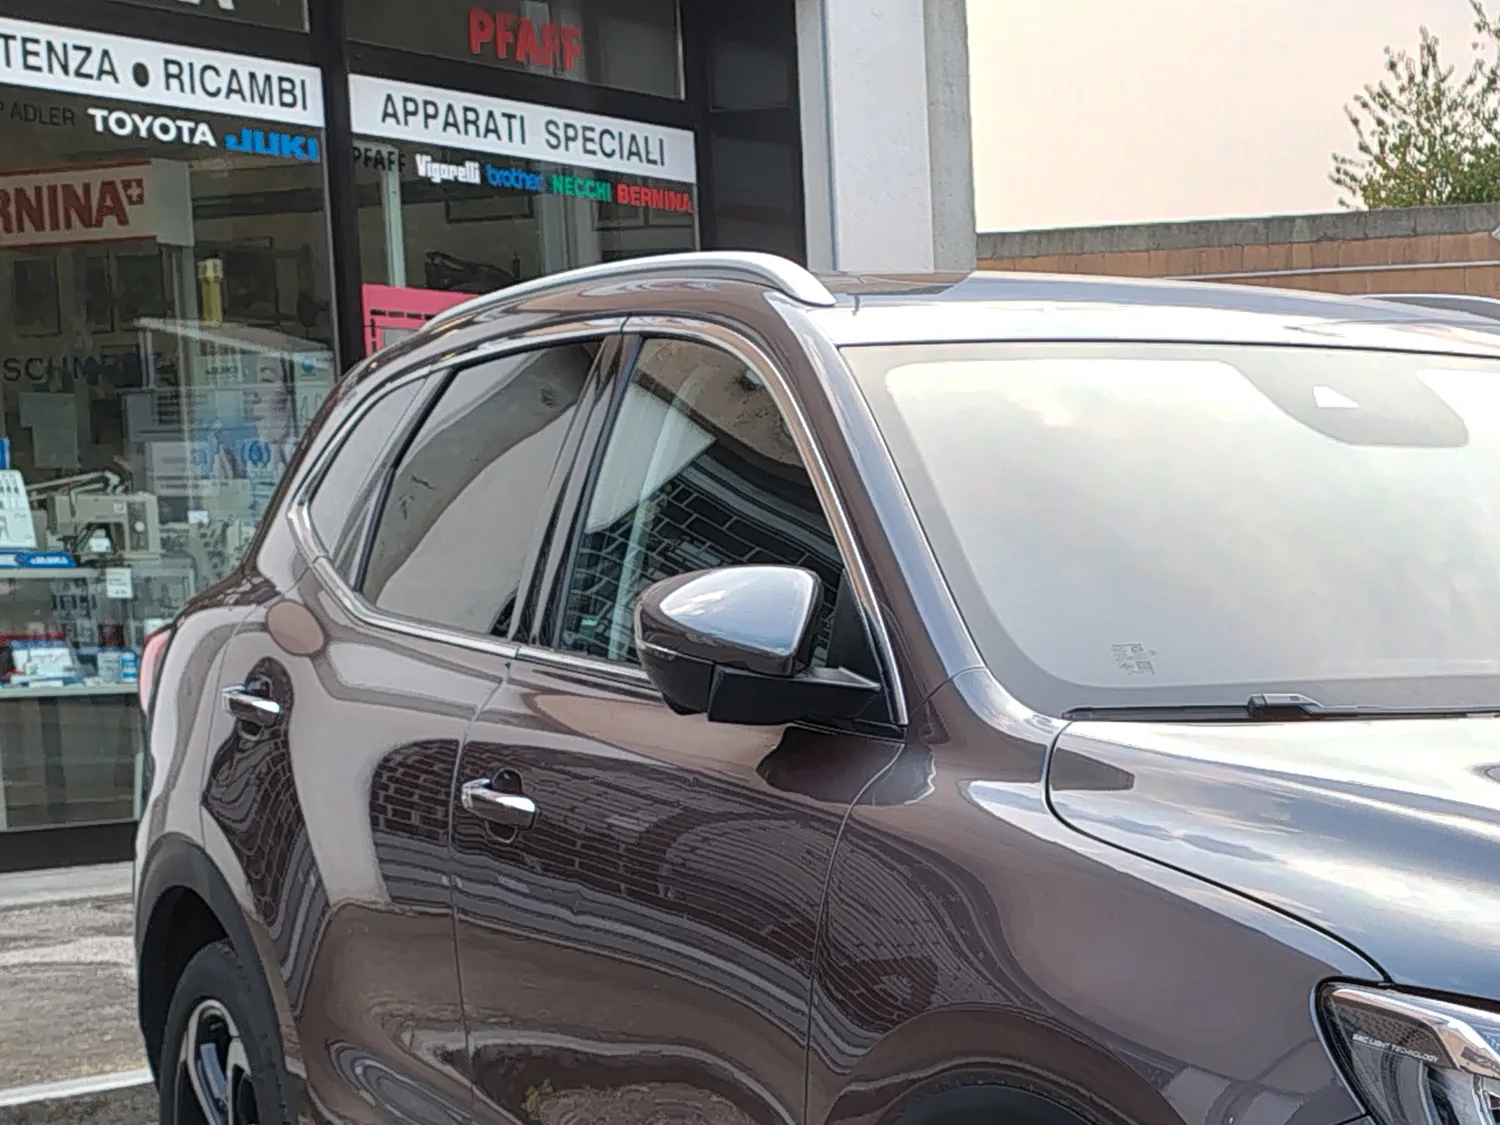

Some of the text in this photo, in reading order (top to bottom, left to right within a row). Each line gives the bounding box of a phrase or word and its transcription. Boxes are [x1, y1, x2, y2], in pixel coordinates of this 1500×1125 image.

[0, 33, 309, 112] TENZA RICAMBI
[468, 7, 582, 72] PFAFF
[10, 101, 76, 127] ADLER
[86, 107, 217, 148] TOYOTA
[223, 127, 319, 162] JUKI
[380, 93, 667, 167] APPARATI SPECIALI
[352, 146, 694, 214] PFAFF Vigorelli brother NECCHI BERNINA
